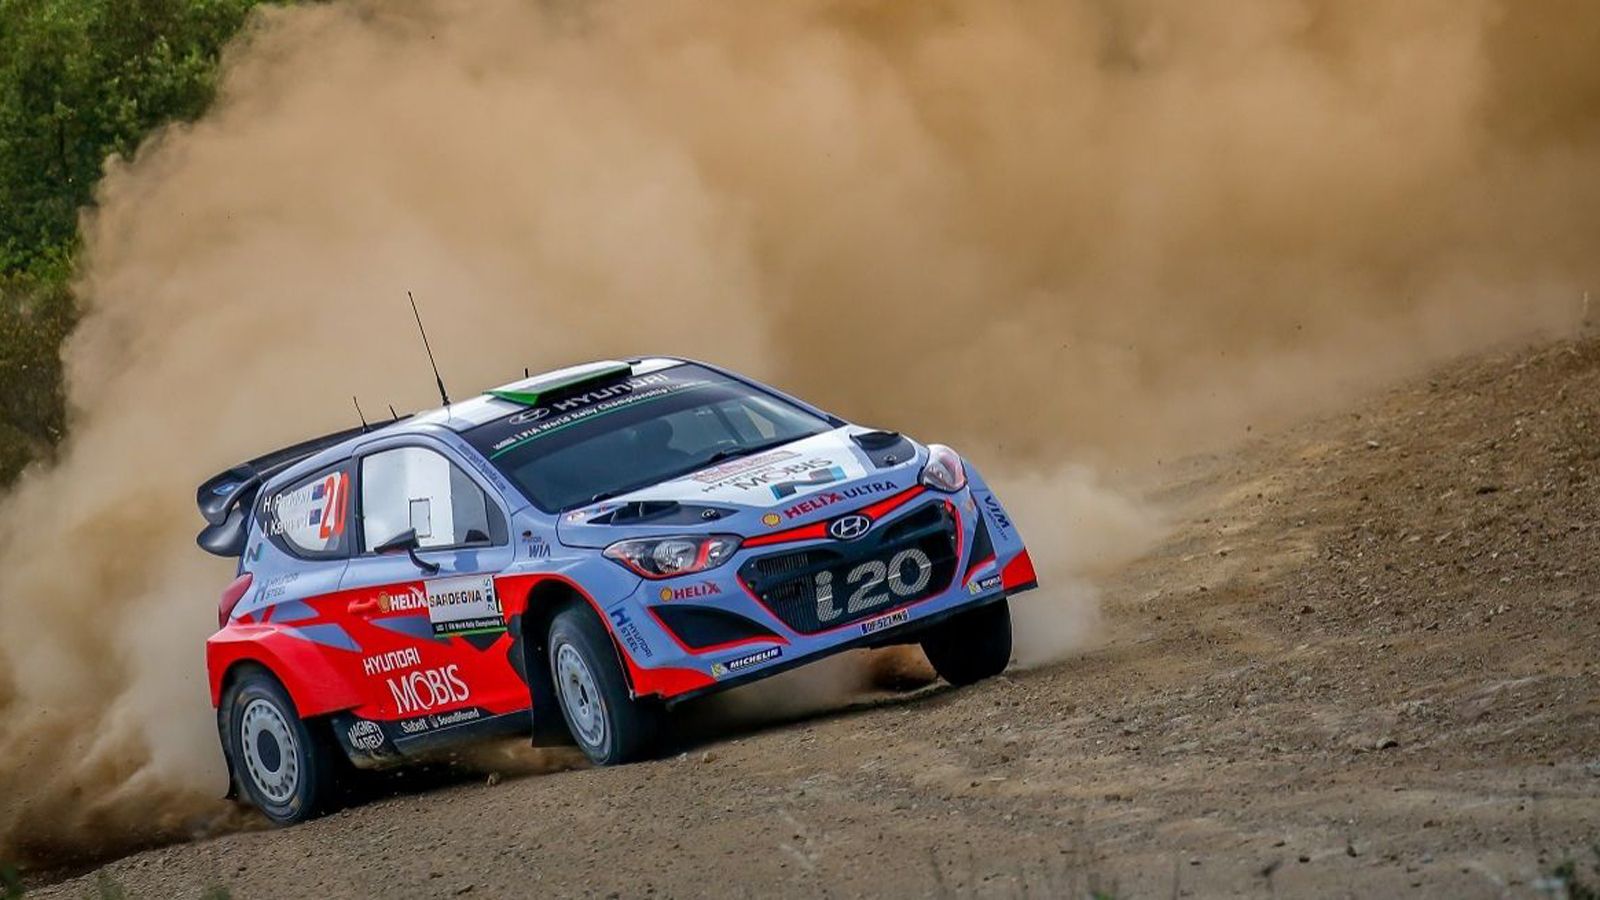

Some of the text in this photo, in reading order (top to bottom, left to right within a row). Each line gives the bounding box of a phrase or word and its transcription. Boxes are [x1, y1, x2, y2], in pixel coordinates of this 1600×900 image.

[553, 373, 669, 412] HYUNDAI
[522, 387, 668, 440] FIA World Rally Championship
[734, 456, 833, 491] MOBIS
[319, 471, 349, 539] 20
[783, 480, 898, 519] HELIX ULTRA
[529, 544, 551, 558] WIA
[389, 585, 428, 612] HELIX
[430, 589, 482, 608] SARDEGNA
[674, 580, 722, 601] HELIX
[815, 548, 932, 622] i20
[620, 625, 639, 653] STEEL
[626, 622, 653, 659] HYUNDAI
[363, 645, 421, 677] HYUNDAI
[729, 648, 778, 670] MICHELIN
[386, 664, 470, 714] MOBIS
